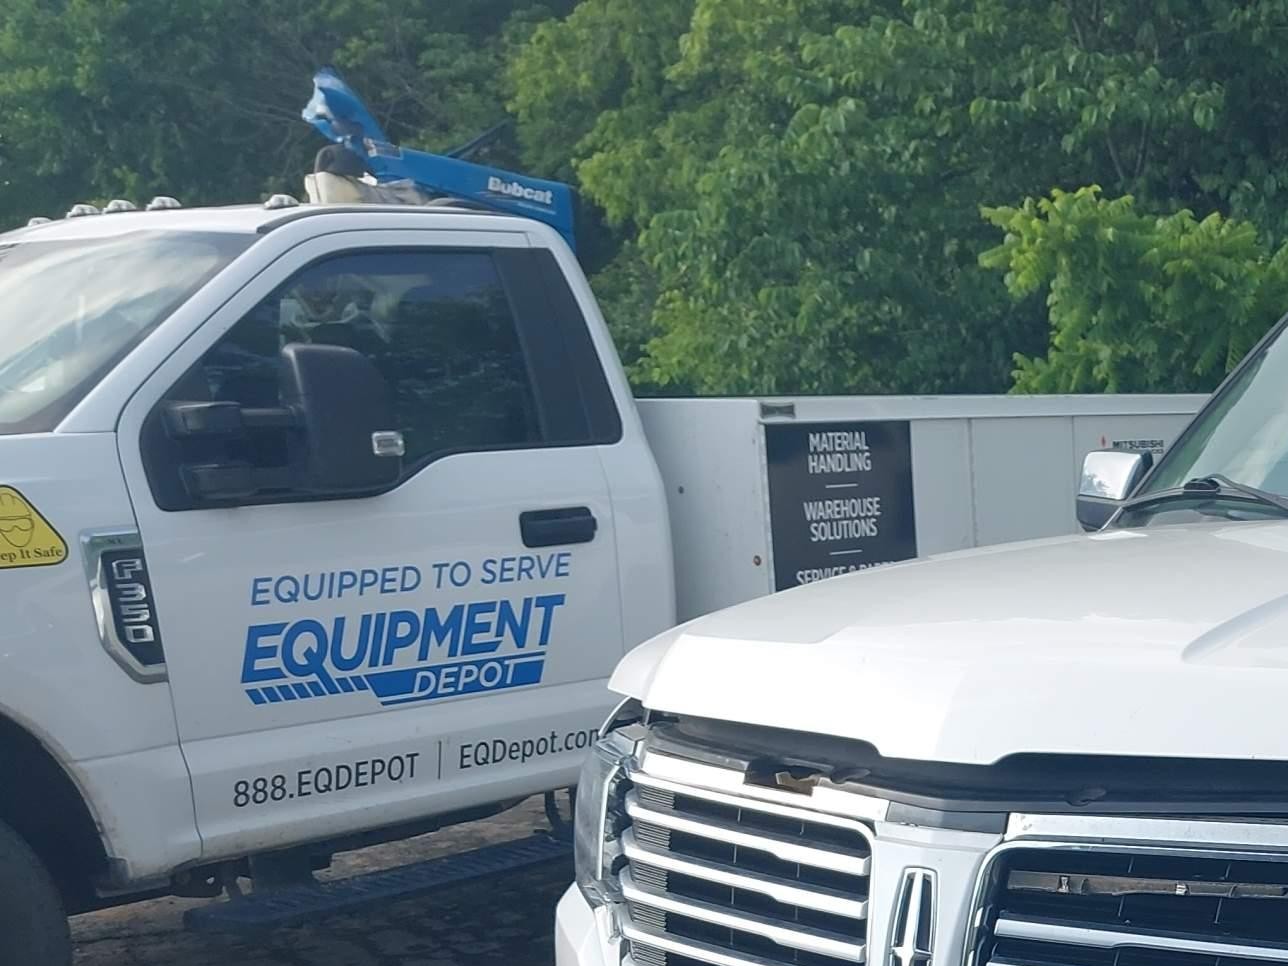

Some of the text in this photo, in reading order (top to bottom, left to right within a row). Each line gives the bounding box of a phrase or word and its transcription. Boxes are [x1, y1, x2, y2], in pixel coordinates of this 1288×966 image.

[487, 176, 554, 204] Bobcat
[809, 432, 869, 452] MATERIAL
[1112, 439, 1164, 449] MITSUBISHI
[808, 452, 872, 474] HANDLING
[804, 497, 882, 521] WAREHOUSE
[810, 518, 878, 542] SOLUTIONS
[0, 546, 63, 563] ep It Safe
[251, 552, 572, 605] EQUIPPED TO SERVE
[240, 594, 566, 693] EQUIPMENT
[413, 660, 516, 696] DEPOT
[233, 753, 420, 807] 888.EQDEPOT
